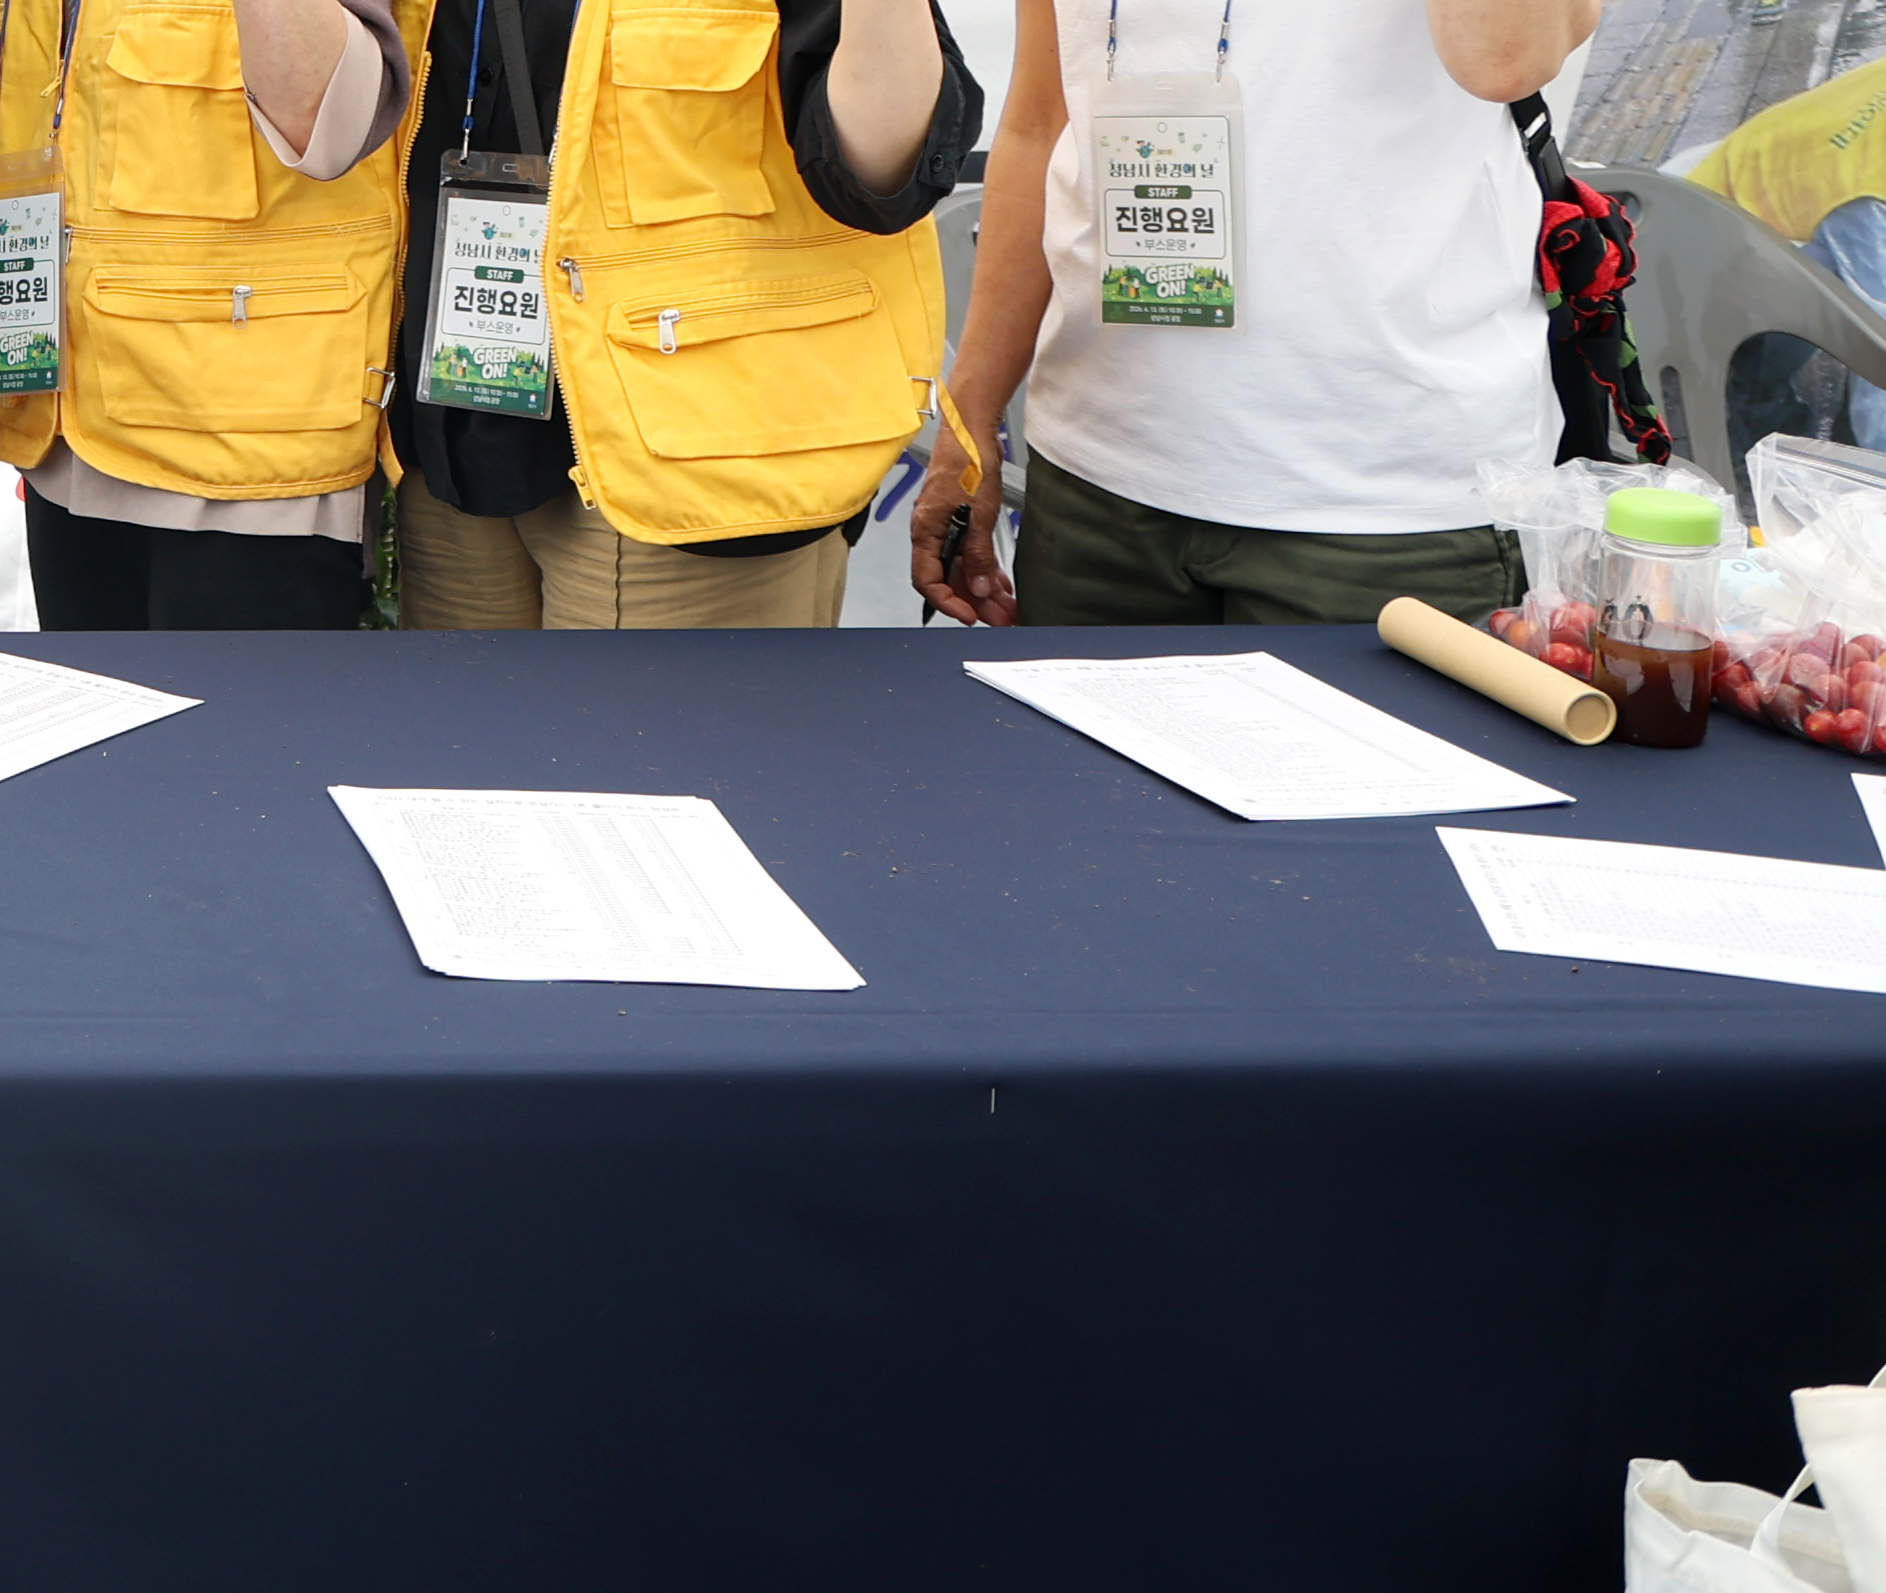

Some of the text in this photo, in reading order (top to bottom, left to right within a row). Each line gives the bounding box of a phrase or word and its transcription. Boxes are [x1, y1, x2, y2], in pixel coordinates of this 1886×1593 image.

[1109, 163, 1214, 178] 성남시 환경의 날
[1148, 188, 1179, 197] STAFF
[1116, 206, 1215, 234] 진행요원
[9, 237, 37, 253] 환경의
[40, 235, 49, 250] 날
[454, 243, 530, 262] 성남시 환경의
[1145, 239, 1188, 252] 부스운영
[4, 262, 25, 271] STAFF
[486, 269, 513, 281] STAFF
[1145, 264, 1195, 284] GREEN
[1156, 280, 1187, 298] ON!
[454, 285, 539, 319] 진행요원
[0, 308, 29, 321] 부스운영
[476, 320, 514, 335] 부스운영
[0, 331, 34, 353] GREEN
[7, 349, 28, 366] ON!
[473, 347, 517, 365] GREEN
[482, 363, 508, 379] ON!
